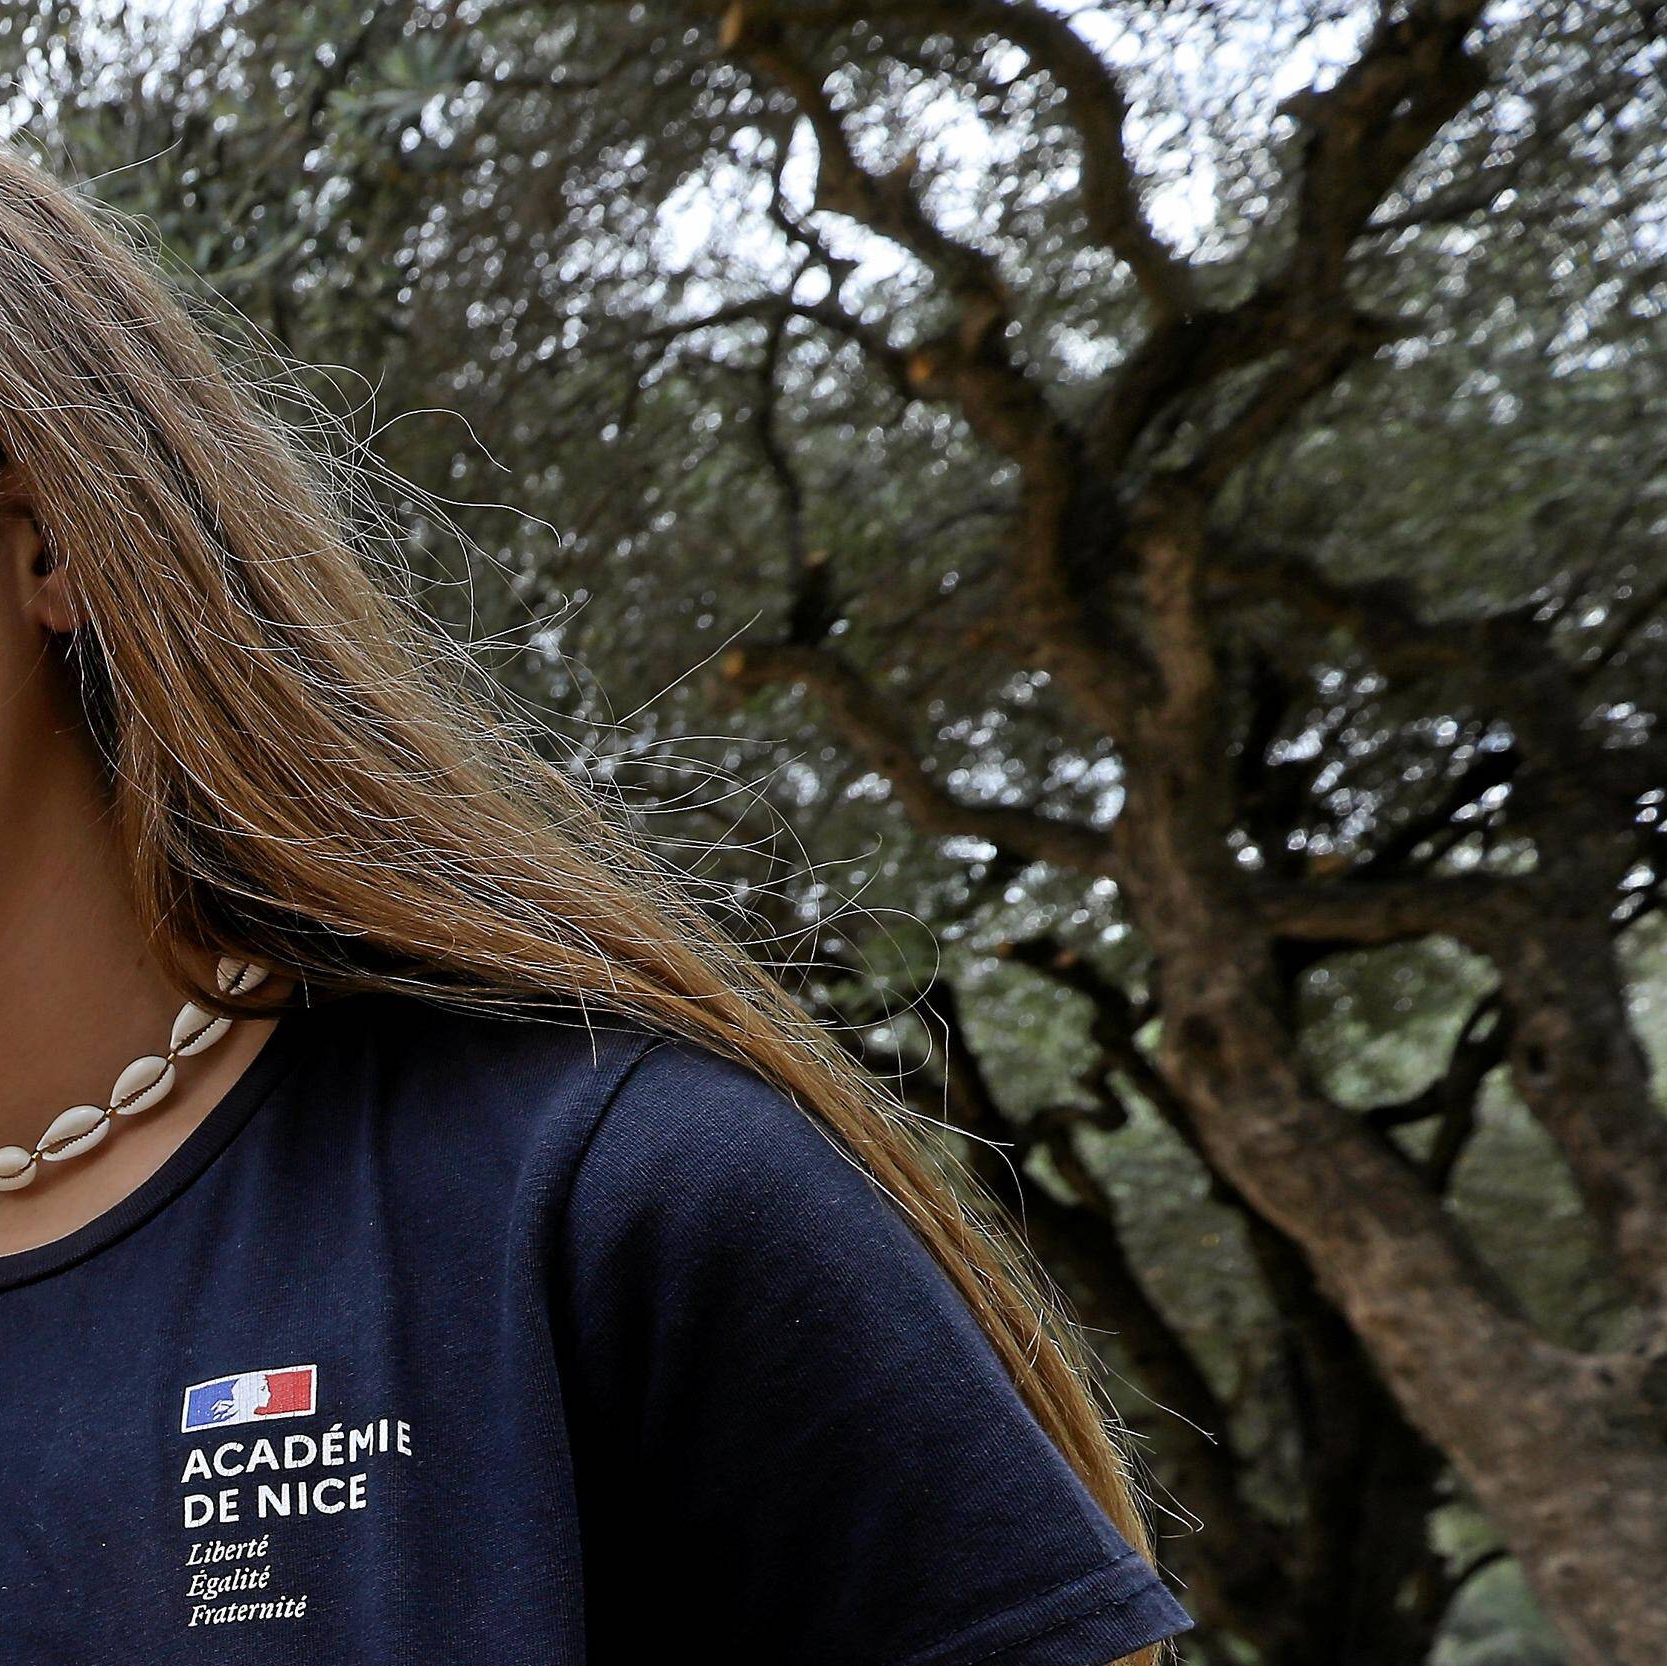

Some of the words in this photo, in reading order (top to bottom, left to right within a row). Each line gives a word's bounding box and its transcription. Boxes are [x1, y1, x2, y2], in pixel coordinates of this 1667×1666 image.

[181, 1418, 413, 1484] ACADÉMIE
[184, 1487, 240, 1529] DE
[258, 1472, 368, 1519] NICE
[186, 1534, 269, 1567] Liberté
[186, 1565, 271, 1600] Égalité
[188, 1595, 308, 1628] Fraternité
